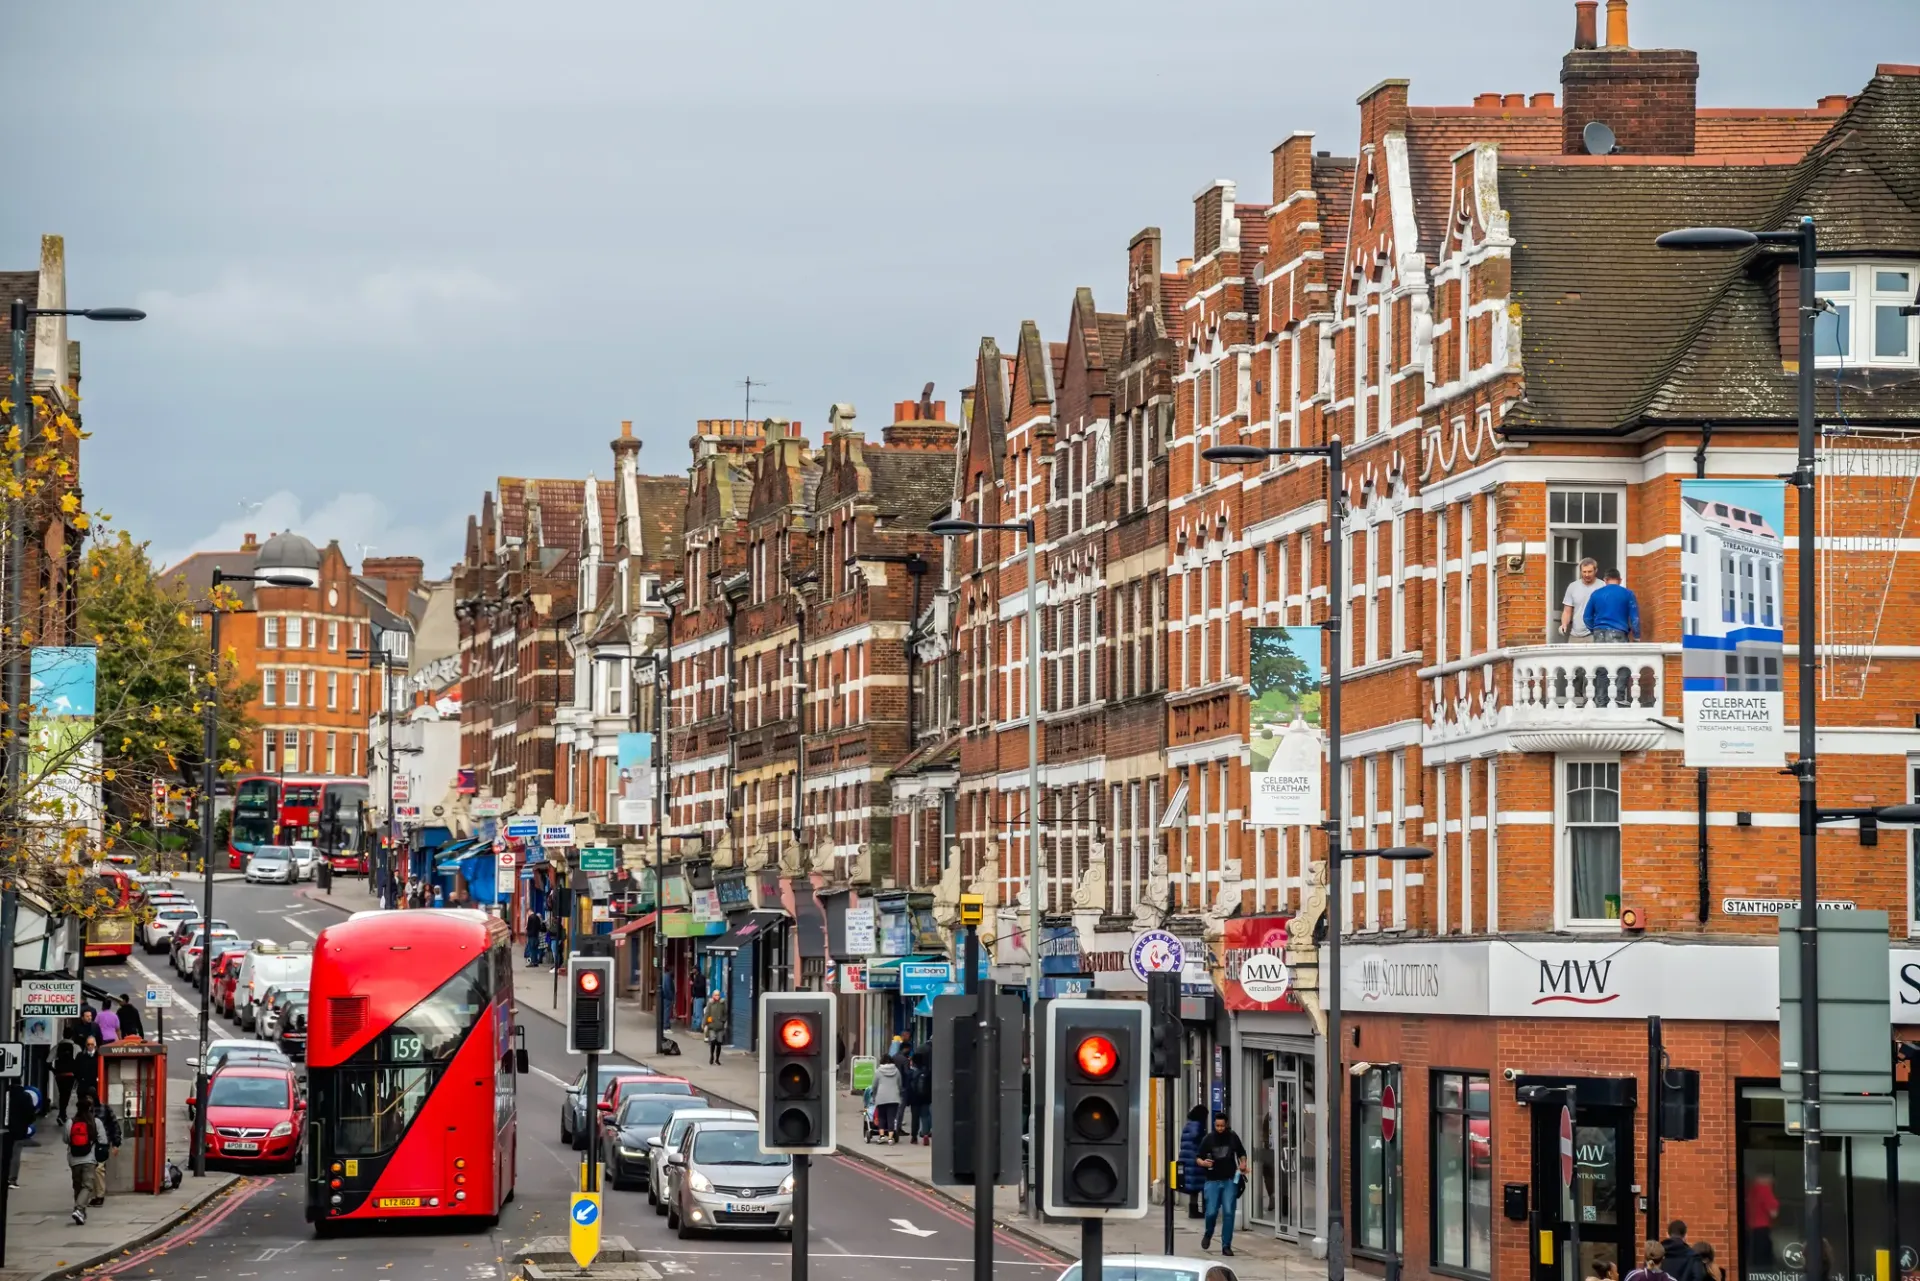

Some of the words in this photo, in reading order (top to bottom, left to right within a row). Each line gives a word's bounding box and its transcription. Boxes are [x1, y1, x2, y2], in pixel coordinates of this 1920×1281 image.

[1722, 541, 1760, 554] STREATHAM
[1702, 698, 1766, 708] CELEBRATE
[1699, 709, 1769, 720] STREATHAM
[1263, 776, 1308, 784] CELEBRATE
[1260, 784, 1311, 792] STREATHAM
[1247, 964, 1282, 980] MW
[1539, 959, 1612, 993] MW
[28, 982, 75, 991] Costcutter
[1066, 981, 1081, 994] 203
[28, 994, 42, 1003] OFF
[43, 994, 76, 1003] LICENCE
[24, 1005, 43, 1014] OPEN
[44, 1005, 58, 1014] TILL
[60, 1005, 77, 1014] LATE
[393, 1038, 421, 1057] 159
